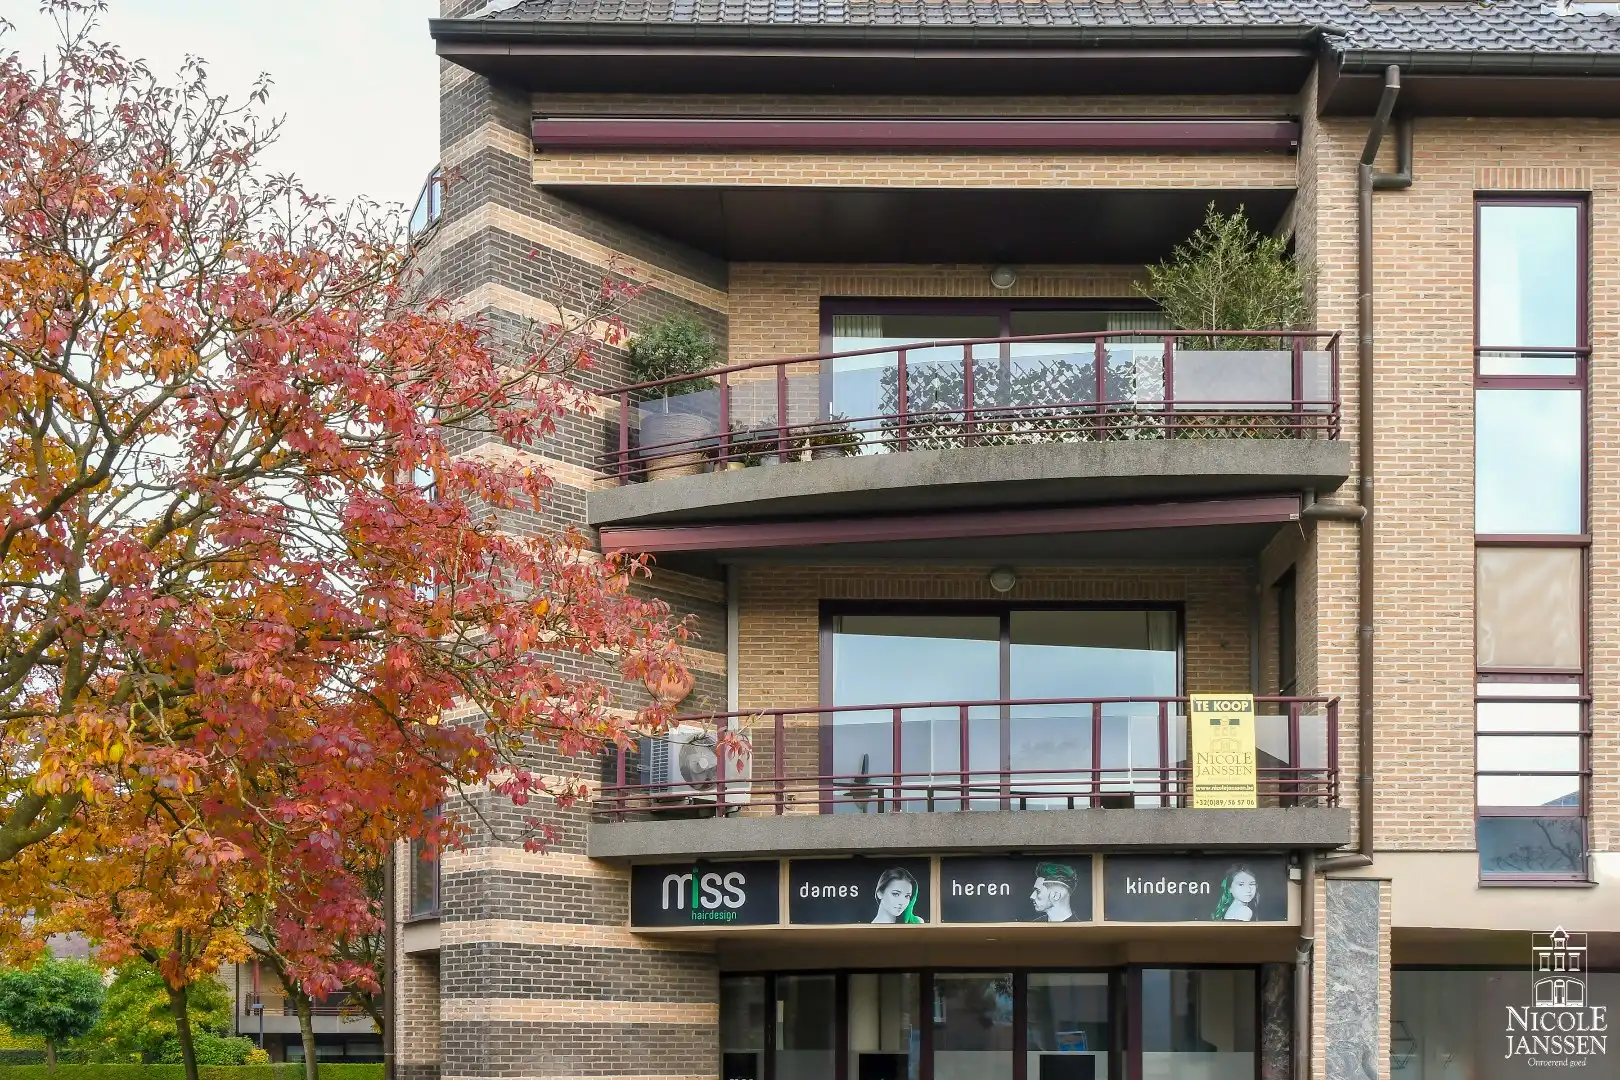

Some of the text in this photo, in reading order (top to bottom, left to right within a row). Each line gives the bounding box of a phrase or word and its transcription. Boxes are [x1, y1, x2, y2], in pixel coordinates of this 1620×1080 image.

[1196, 701, 1249, 711] TE KOOP
[1197, 752, 1253, 764] NICOLE
[1196, 765, 1253, 777] JANSSEN
[662, 870, 746, 910] miss
[800, 881, 859, 898] dames
[952, 879, 1011, 897] heren
[1126, 877, 1211, 895] kinderen
[691, 910, 737, 921] hairdesign
